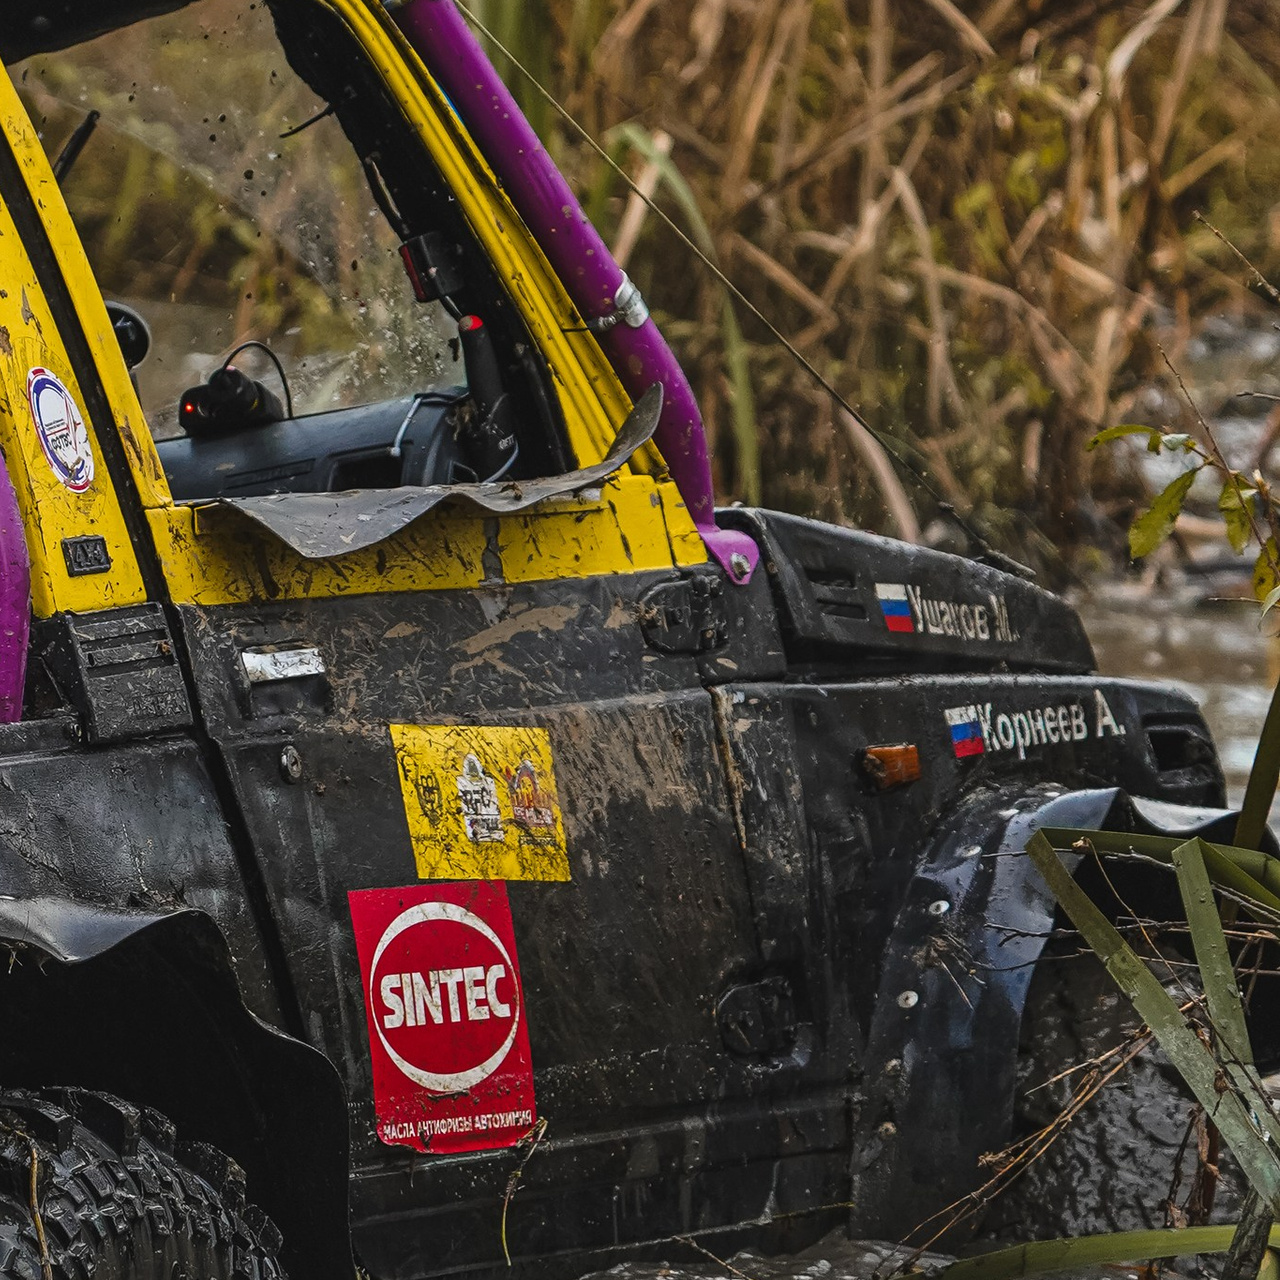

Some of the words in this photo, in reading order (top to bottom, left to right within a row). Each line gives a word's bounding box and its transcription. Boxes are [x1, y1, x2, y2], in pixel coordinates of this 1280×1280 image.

[976, 702, 1088, 761] Корнеев
[1093, 688, 1127, 739] А.
[380, 963, 512, 1030] SINTEC
[417, 1115, 473, 1137] АНТИФРИЗЫ
[474, 1108, 533, 1131] АВТОХИМИЯ
